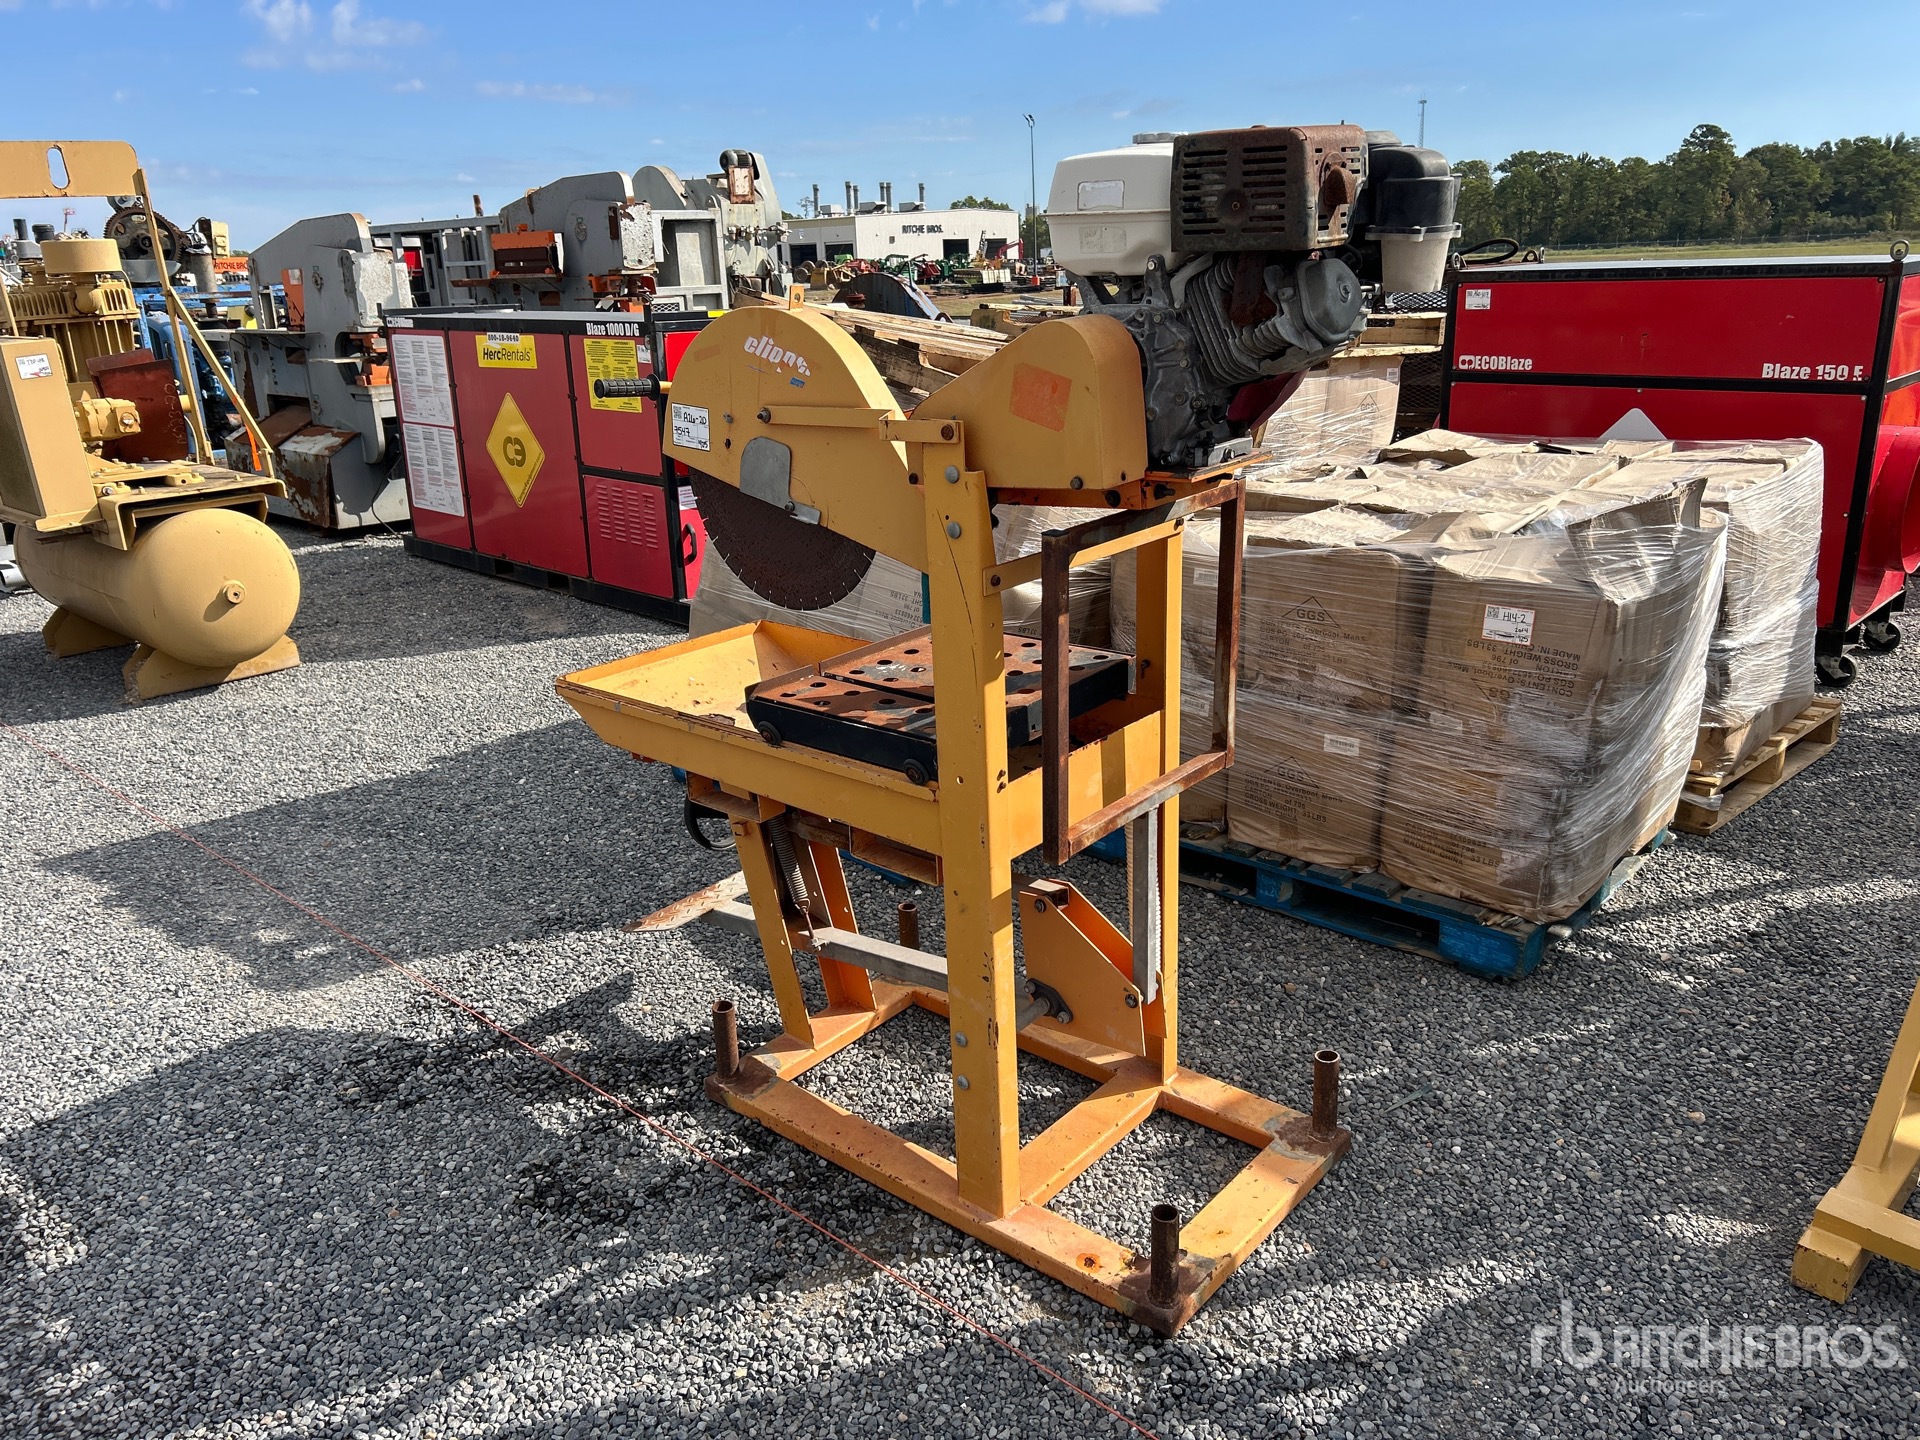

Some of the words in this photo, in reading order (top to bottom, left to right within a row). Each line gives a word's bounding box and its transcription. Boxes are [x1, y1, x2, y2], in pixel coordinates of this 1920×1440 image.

[901, 224, 925, 234] RITCHIE
[236, 261, 249, 270] BRO
[586, 322, 606, 336] Blaze
[606, 322, 624, 336] 1000
[625, 323, 640, 337] D/G
[1761, 362, 1811, 380] Blaze
[1815, 364, 1850, 381] 150
[1296, 608, 1325, 621] GGS
[1502, 611, 1526, 623] H14-2
[1486, 643, 1497, 652] 33
[1491, 654, 1504, 663] 796
[1552, 648, 1581, 660] MADE
[1507, 657, 1519, 665] of
[1543, 657, 1579, 670] GROSS
[1553, 679, 1575, 689] GGS
